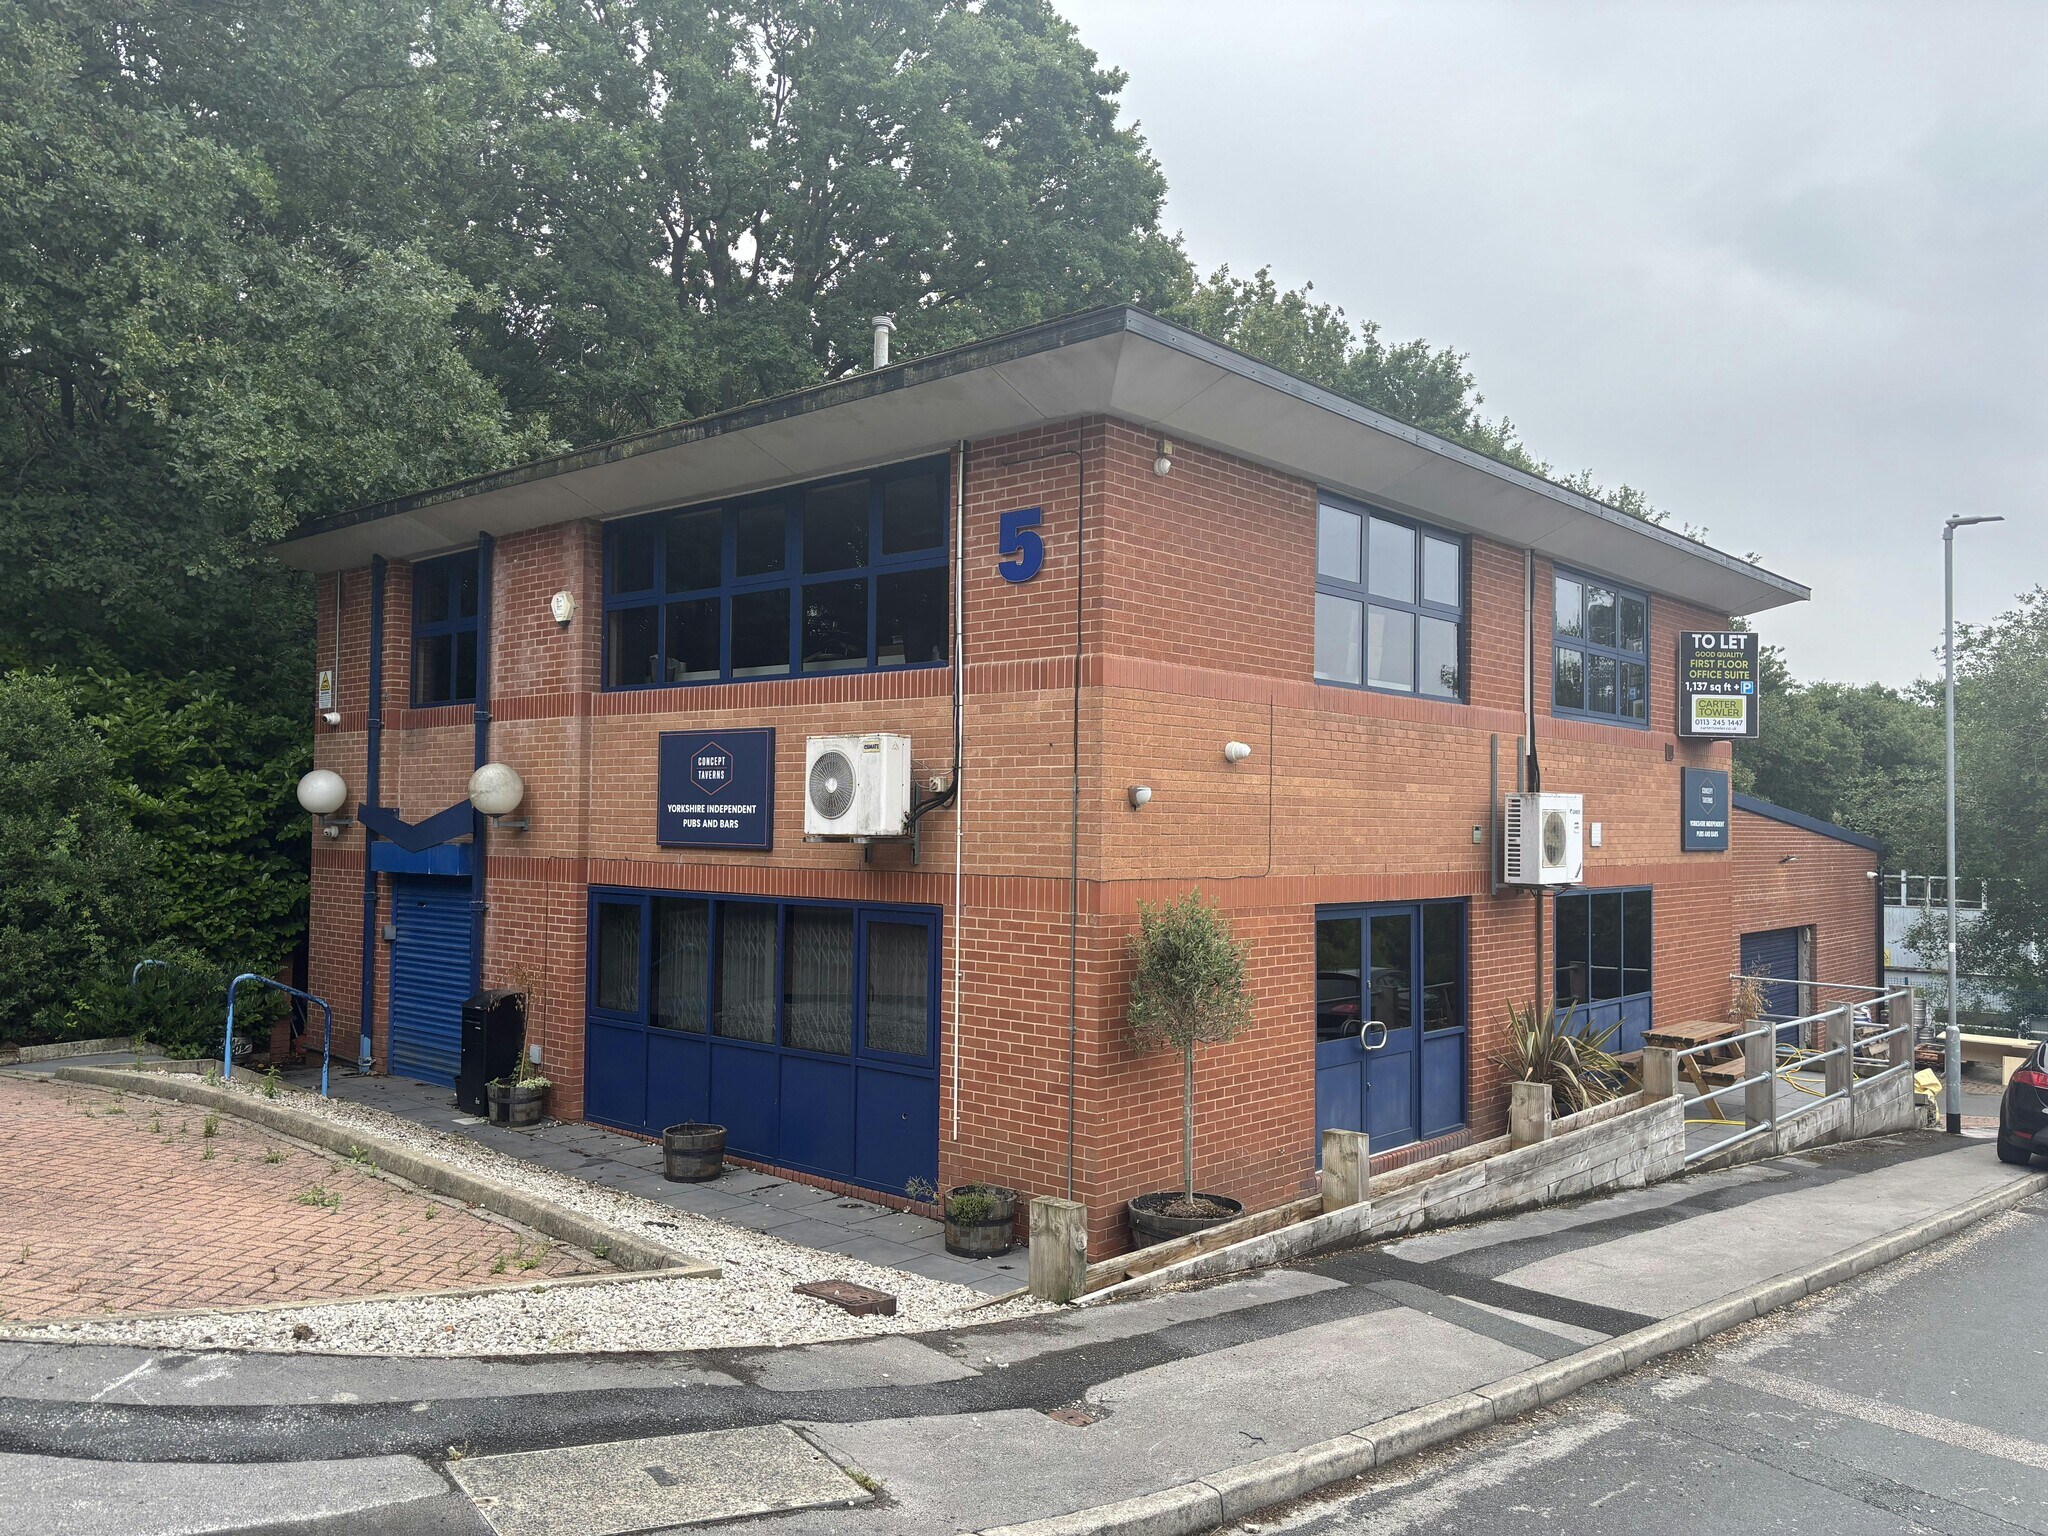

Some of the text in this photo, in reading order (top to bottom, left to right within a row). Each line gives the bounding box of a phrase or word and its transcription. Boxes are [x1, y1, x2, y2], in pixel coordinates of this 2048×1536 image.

[998, 506, 1044, 582] 5
[1691, 633, 1748, 650] TO LET
[1716, 651, 1744, 659] QUALITY
[1690, 659, 1749, 669] FIRST FLOOR
[1689, 669, 1750, 680] OFFICE SUITE
[1685, 681, 1708, 692] 1,137
[1709, 684, 1722, 694] sq
[1723, 682, 1732, 692] ft
[1698, 699, 1737, 708] CARTER
[1699, 708, 1740, 717] TOWLER
[1694, 718, 1710, 726] 0113
[1712, 718, 1726, 726] 245
[697, 756, 726, 766] CONCEPT
[697, 770, 725, 780] TAVERNS
[667, 804, 757, 814] YORKSHIRE INDEPENDENT
[682, 818, 739, 829] PUBS AND BARS
